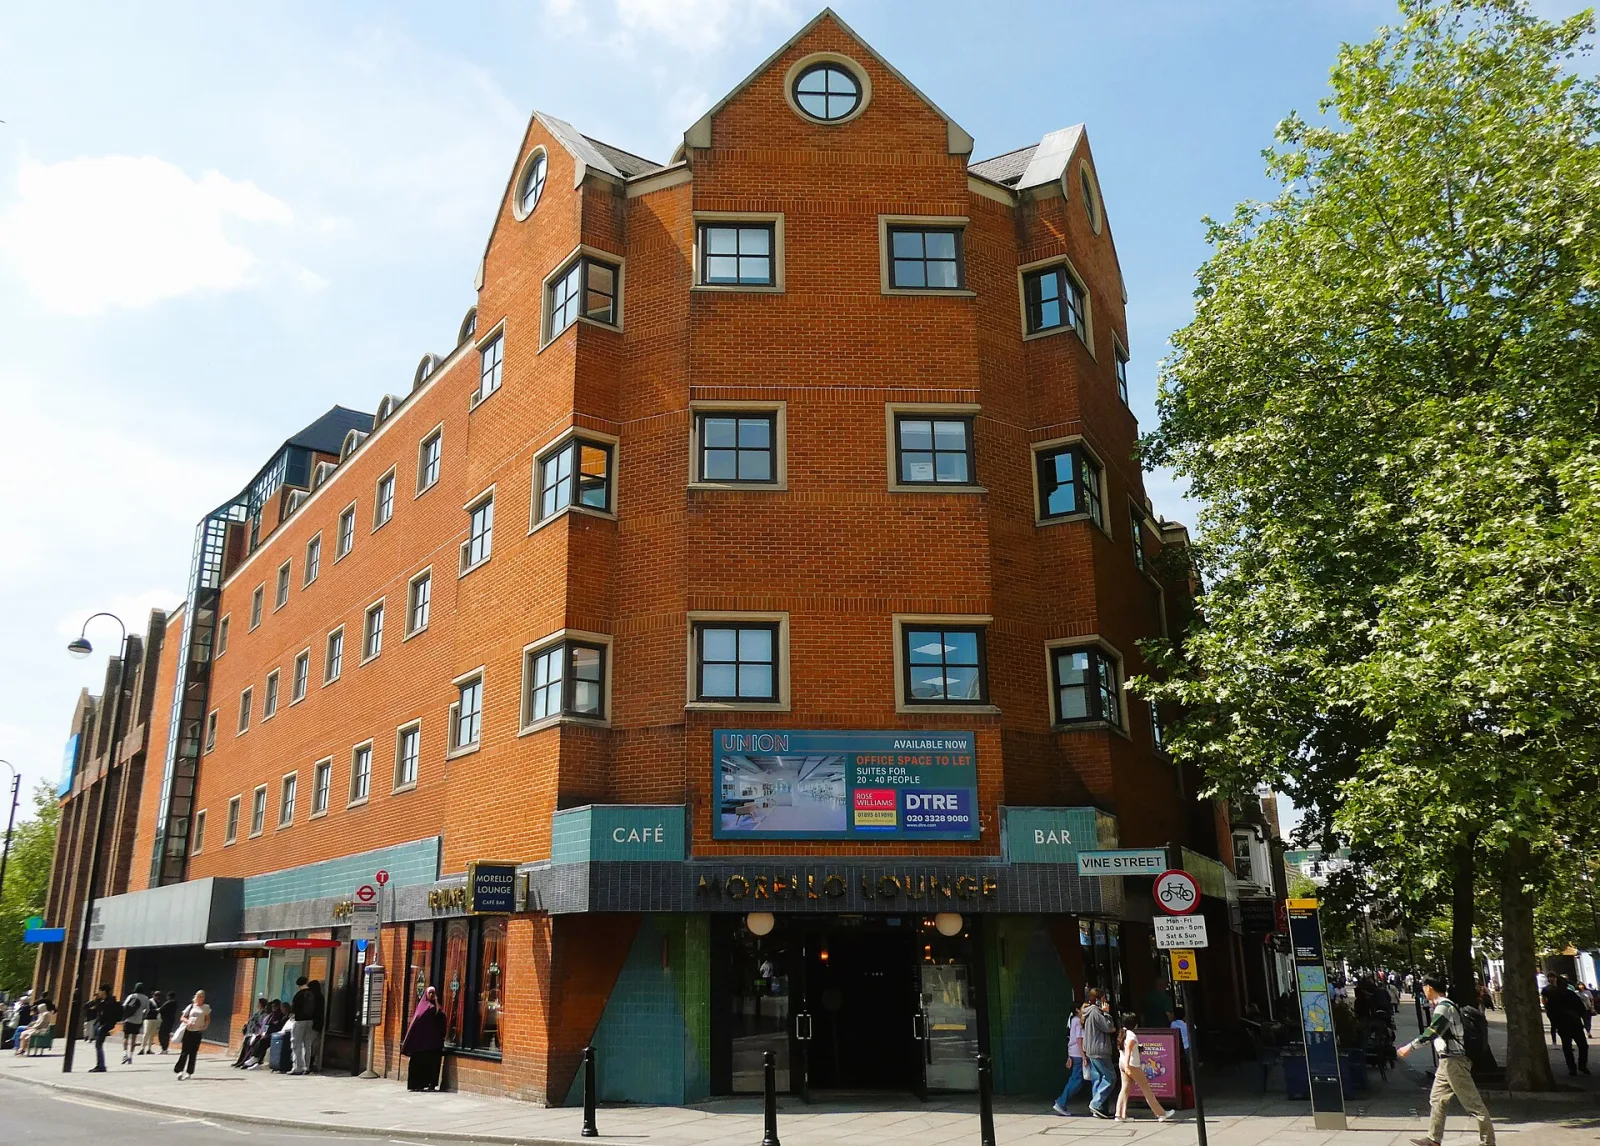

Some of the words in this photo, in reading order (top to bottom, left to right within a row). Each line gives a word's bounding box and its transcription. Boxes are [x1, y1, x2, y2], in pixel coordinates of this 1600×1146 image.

[722, 734, 788, 751] UNION
[894, 740, 943, 749] AVAILABLE
[945, 740, 967, 749] NOW
[856, 755, 895, 765] OFFICE
[898, 756, 932, 765] SPACE
[936, 756, 949, 765] TO
[953, 756, 971, 765] LET
[856, 767, 887, 775] SUITES
[857, 776, 867, 784] 20
[875, 776, 885, 784] 40
[887, 776, 920, 784] PEOPLE
[906, 795, 958, 810] DTRE
[612, 824, 664, 843] CAFÉ
[1034, 829, 1071, 844] BAR
[1082, 858, 1110, 868] VINE
[1113, 857, 1161, 867] STREET
[380, 872, 386, 882] T
[476, 875, 513, 883] MORELLO
[477, 886, 511, 894] LOUNGE
[697, 874, 848, 899] MORELLO
[862, 875, 998, 899] LOUNGE
